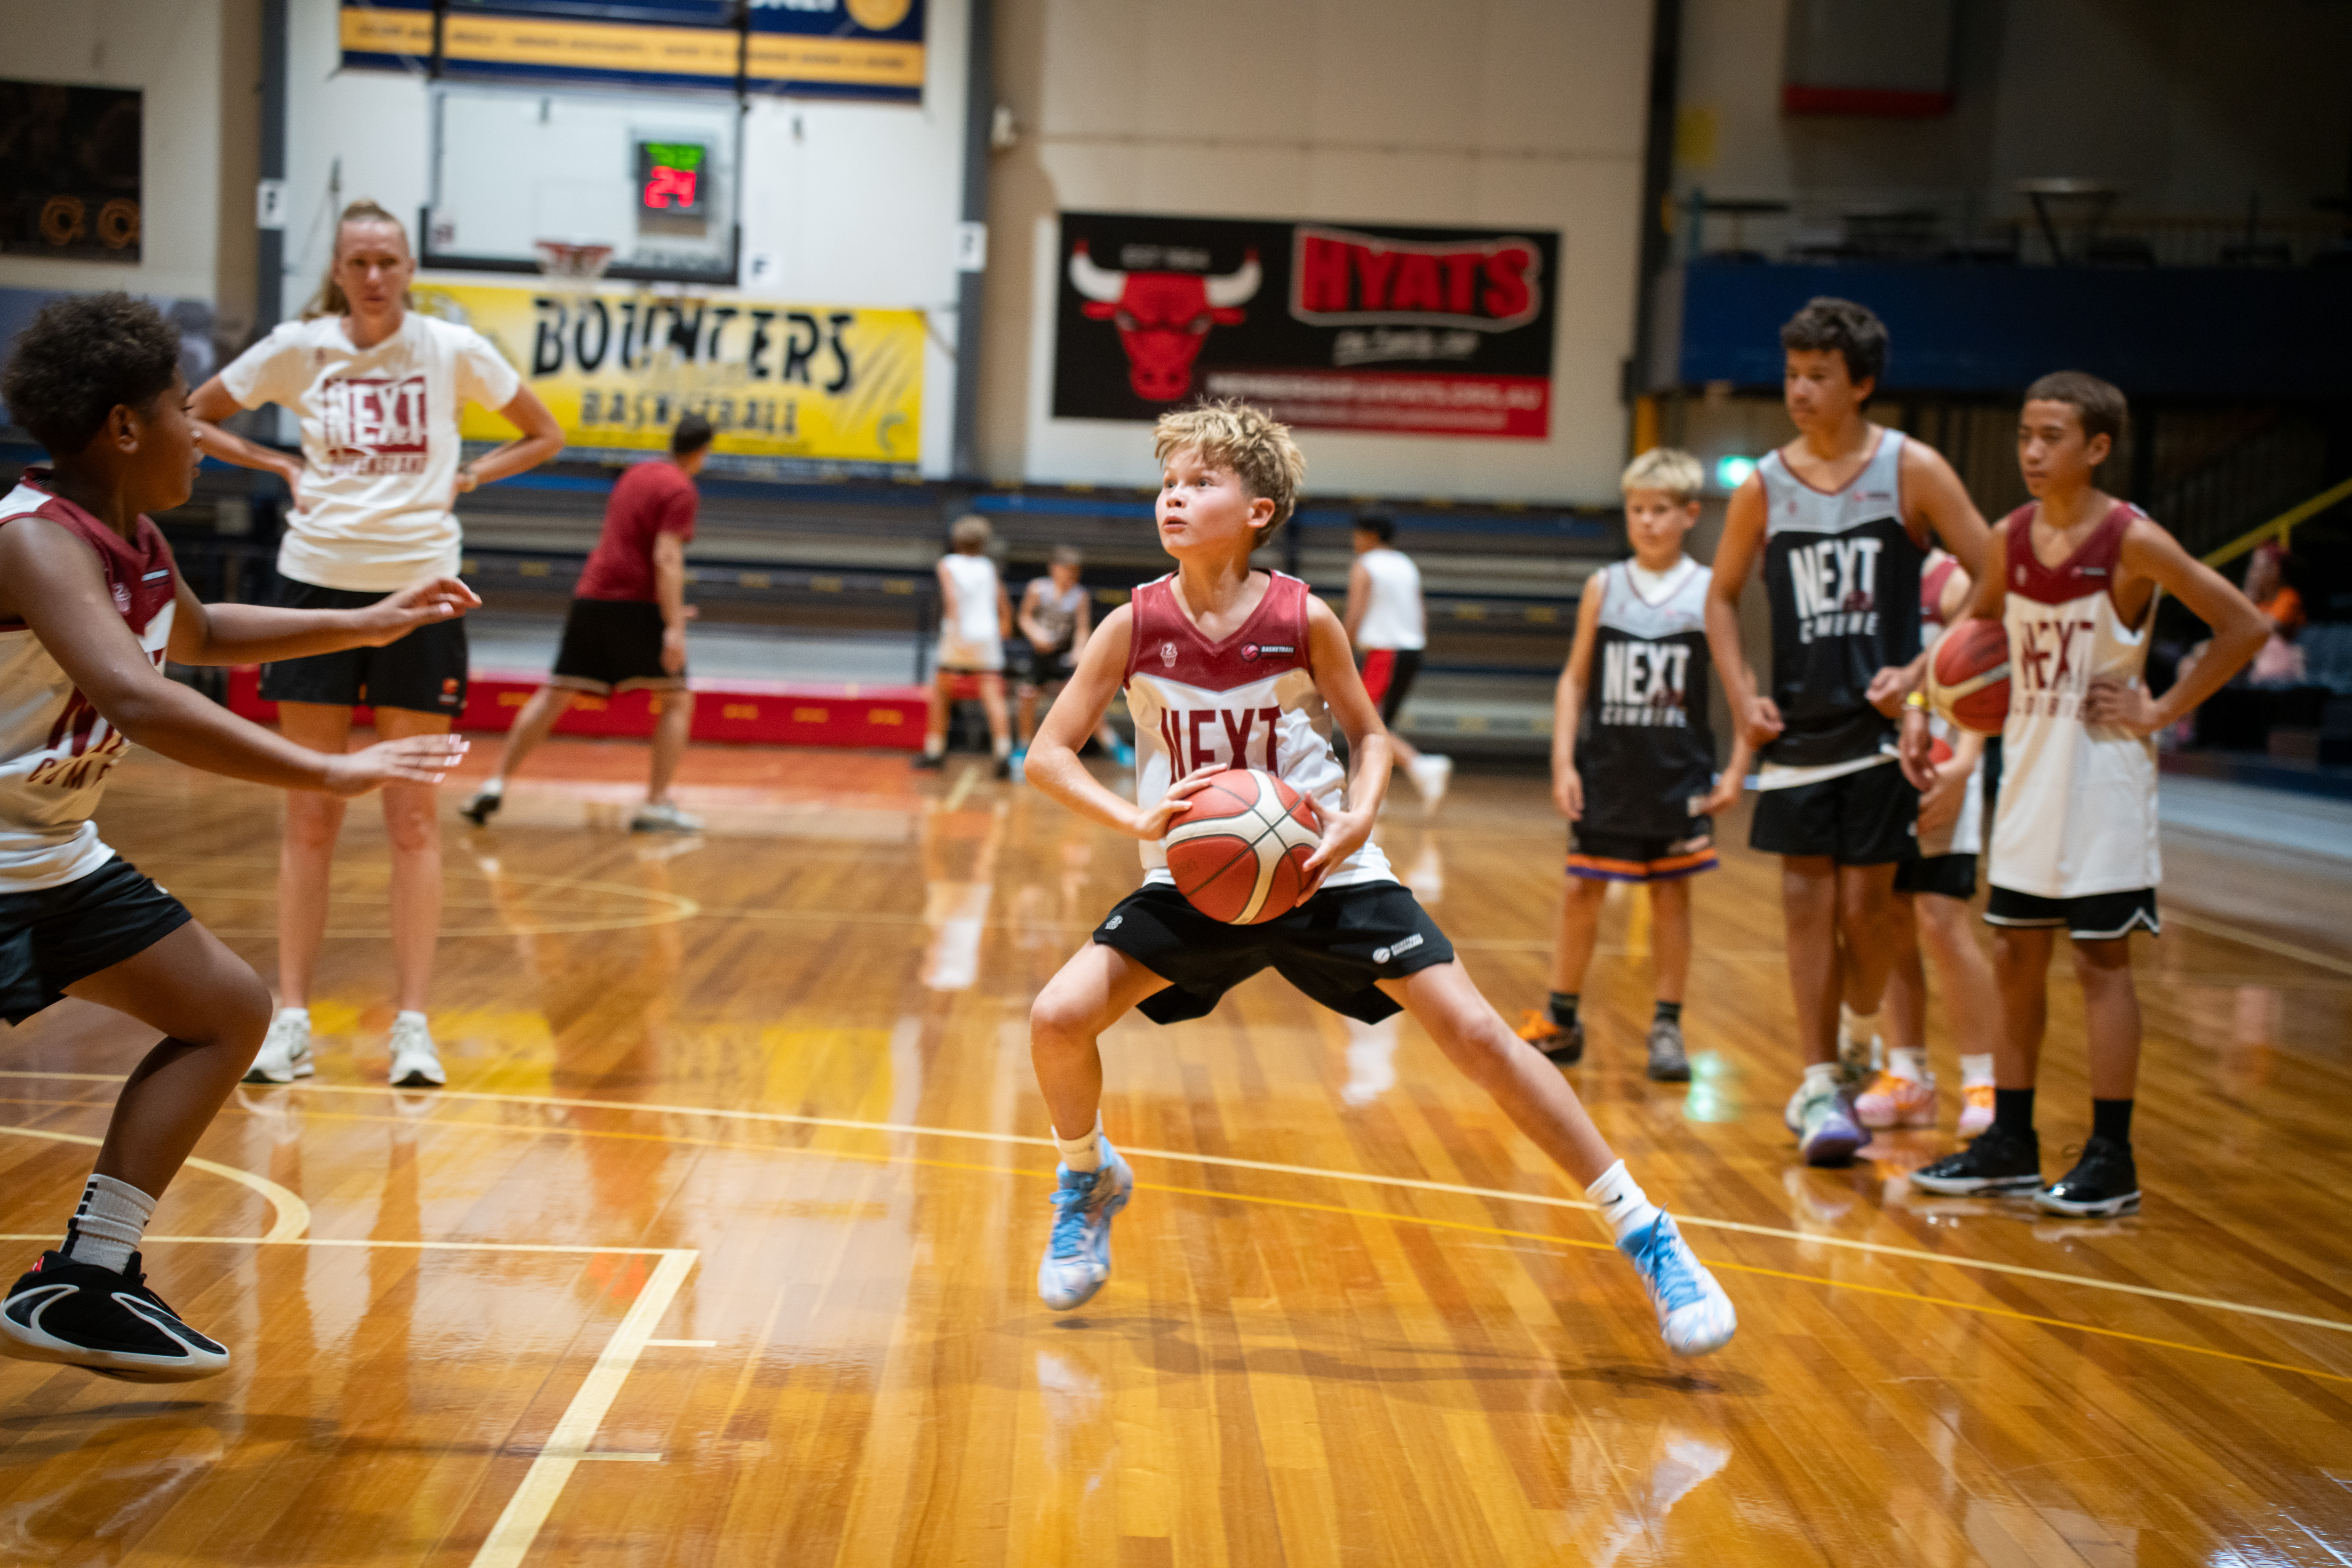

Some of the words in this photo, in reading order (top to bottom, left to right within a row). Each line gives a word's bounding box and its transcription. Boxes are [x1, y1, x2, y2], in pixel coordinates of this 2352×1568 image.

[644, 166, 697, 208] 24
[1302, 236, 1529, 321] HYATS
[581, 390, 798, 436] BASKTBALL
[1788, 537, 1883, 621] NEXT
[1602, 640, 1691, 706] NEXT
[1160, 704, 1282, 785] NEXT
